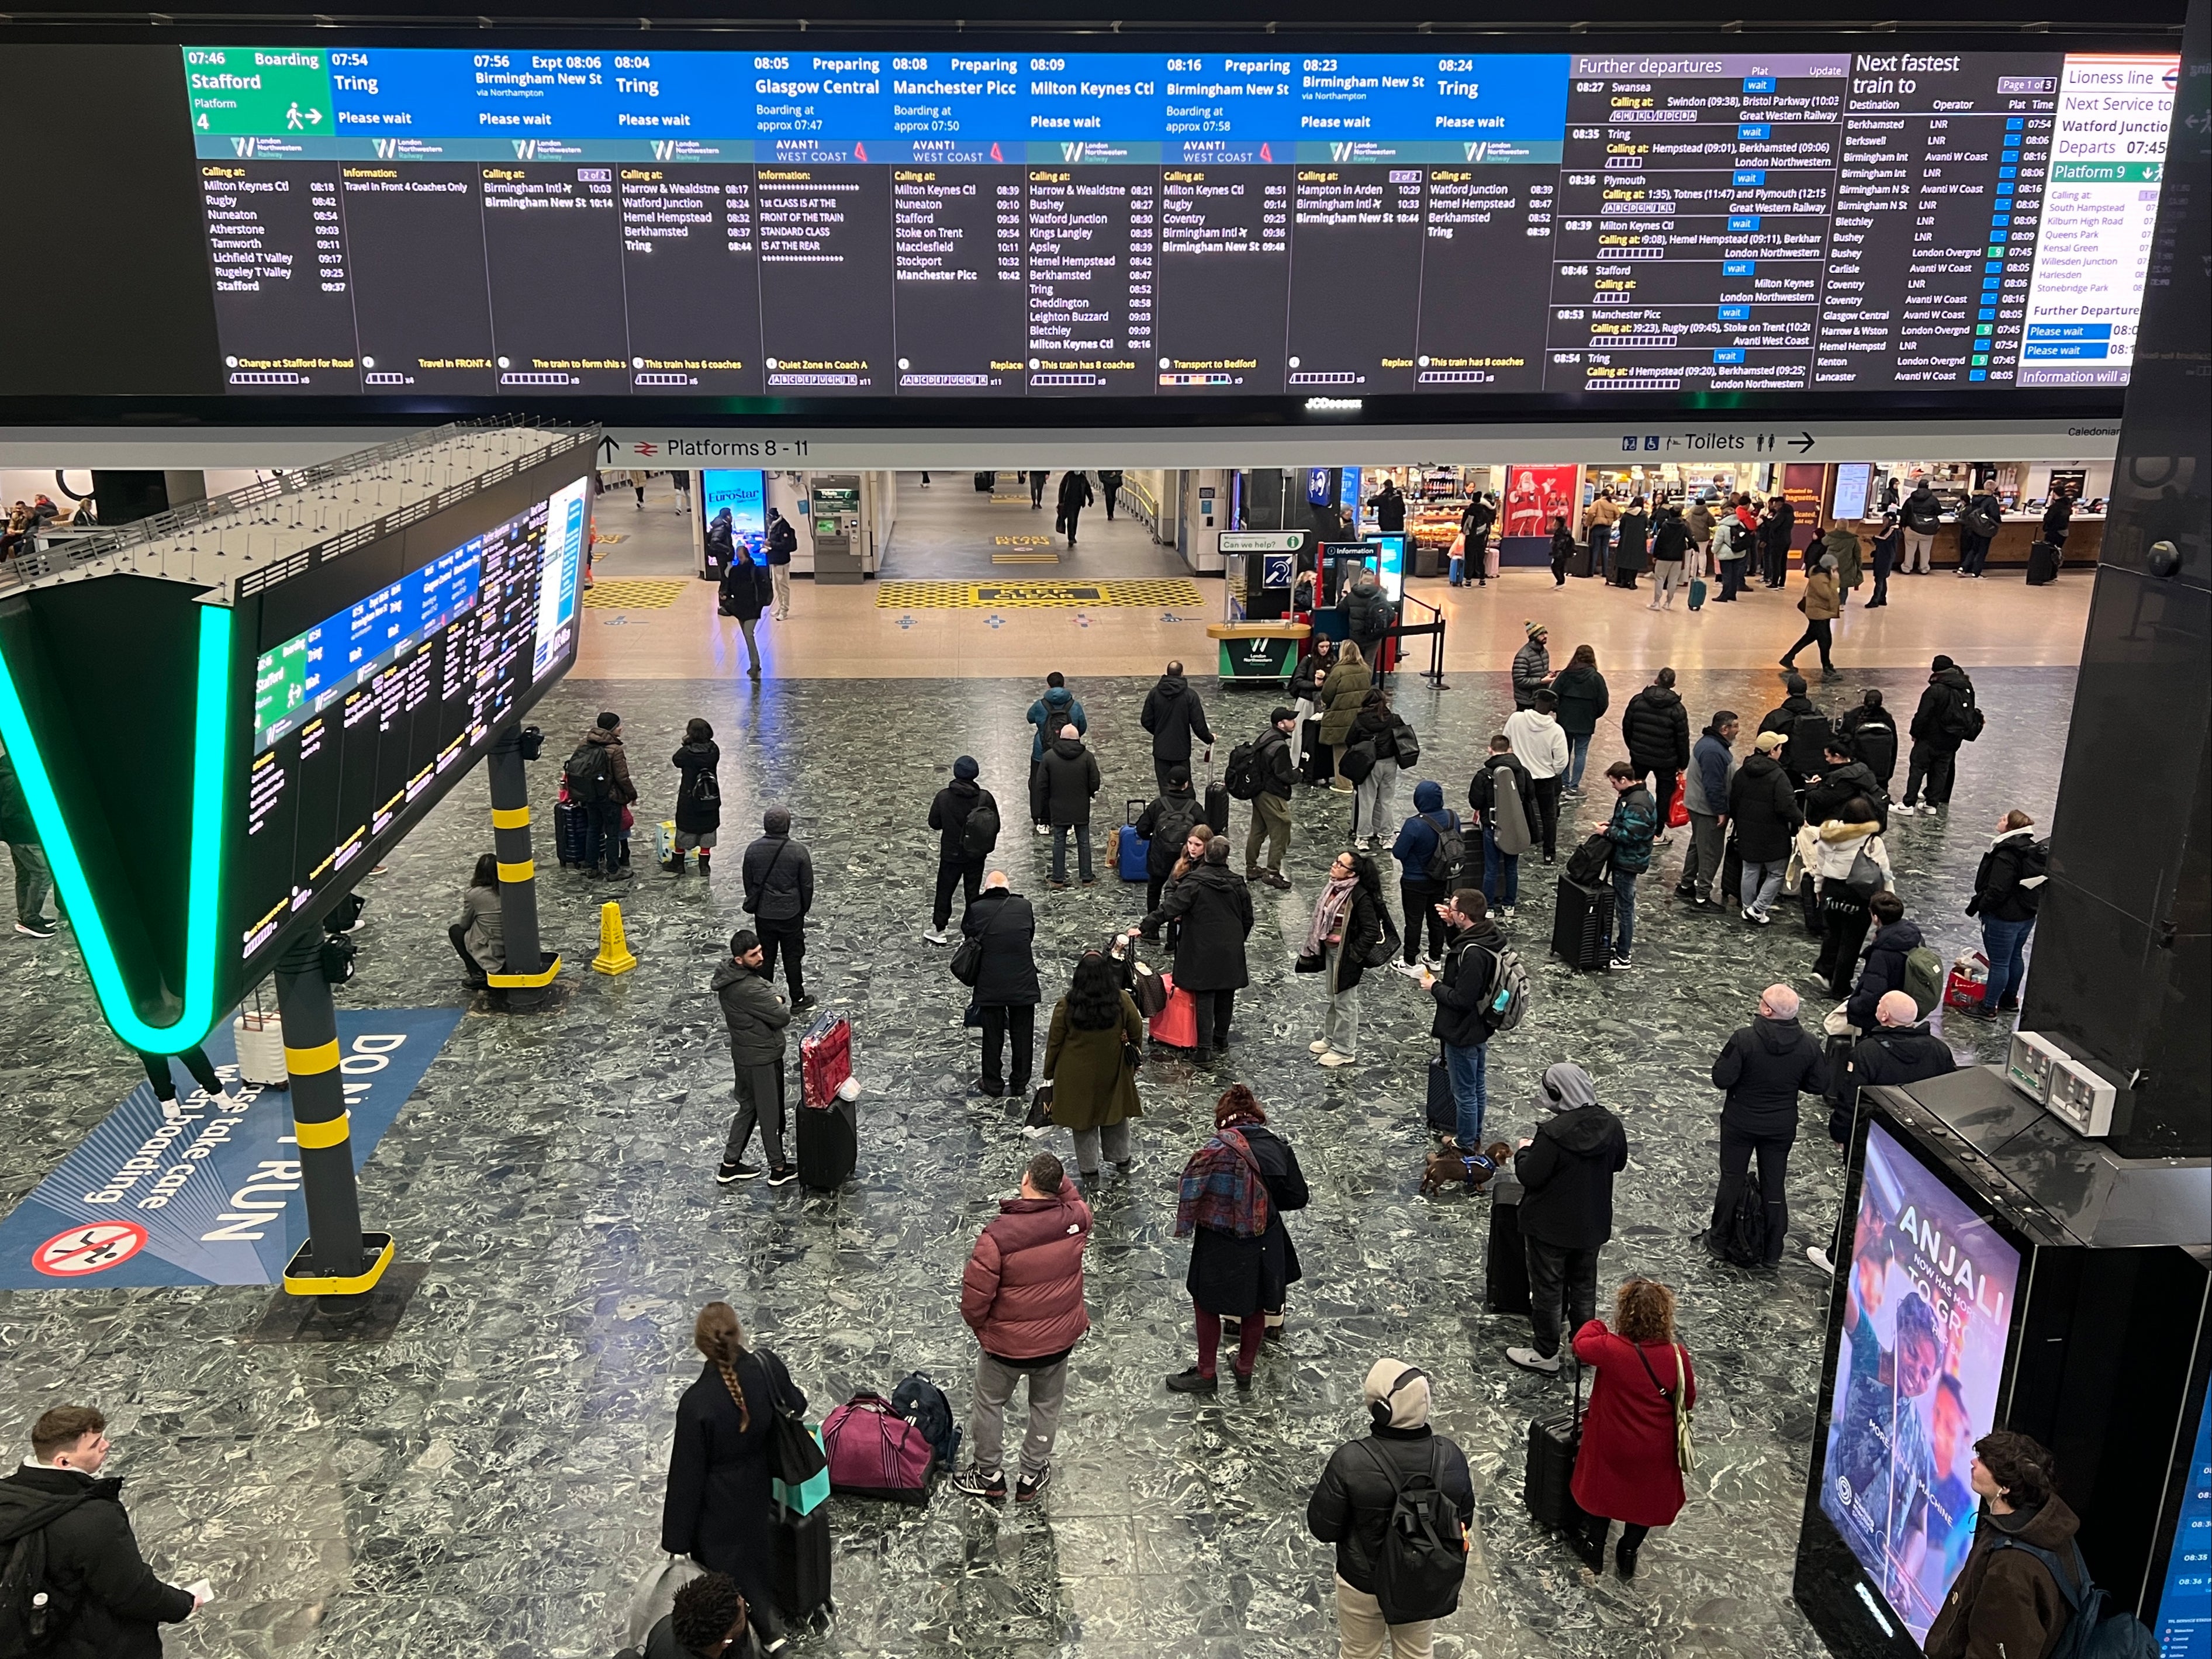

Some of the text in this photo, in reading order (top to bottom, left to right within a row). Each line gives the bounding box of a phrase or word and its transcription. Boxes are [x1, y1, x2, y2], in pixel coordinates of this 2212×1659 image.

[189, 52, 318, 68] 07:46 Boarding
[332, 54, 368, 65] 07:54
[474, 56, 601, 70] 07:56 Expt 08:06
[1031, 59, 1064, 71] 08:09
[1857, 55, 1960, 71] Next fastest
[755, 58, 880, 74] 08:05 Preparing
[893, 58, 1017, 74] 08:08 Preparing
[1167, 60, 1291, 74] 08:16 Preparing
[1579, 59, 1722, 77] Further departures
[1751, 67, 1841, 77] Plat Update
[192, 75, 261, 89] Stafford
[476, 72, 602, 86] Birmingham New St
[2069, 71, 2153, 85] Lioness line
[334, 77, 378, 94] Tring
[755, 80, 879, 96] Glasgow Central
[894, 81, 1016, 95] Manchester Picc
[1031, 82, 1154, 98] Milton Keynes Ctl
[1577, 80, 1767, 92] 08:27 Swansea wait
[1853, 78, 1916, 94] train to
[490, 89, 544, 98] Northampton
[195, 98, 236, 109] Platform
[1850, 99, 2054, 111] Destination Operator Plat Time
[2065, 98, 2172, 112] Next Service to
[756, 104, 814, 117] Boarding at
[198, 113, 209, 129] 4
[338, 112, 412, 124] Please wait
[758, 120, 822, 132] approx 07:47
[1848, 119, 2051, 130] Berkhamsted LNR 07:54
[776, 141, 818, 149] AVANTI
[1846, 136, 2049, 146] Berkswell LNR 08:06
[2059, 141, 2165, 156] Departs 07:45
[777, 152, 846, 162] WEST COAST
[203, 167, 245, 178] Calling at:
[344, 168, 397, 179] Information:
[2055, 165, 2125, 178] Platform 9
[205, 181, 334, 193] Milton Keynes Ctl 08:18
[1569, 175, 1646, 187] 08:36 Plymouth
[622, 183, 748, 195] Harrow & Wealdstne 08:17
[207, 195, 336, 208] Rugby 08:42
[2050, 203, 2124, 213] South Hampstead
[208, 210, 337, 221] Nuneaton 08:54
[1163, 213, 1285, 225] Coventry 09:25
[2047, 217, 2123, 226] Kilburn High Road
[210, 224, 339, 235] Atherstone 09:03
[896, 227, 1019, 239] Stoke on Trent 09:54
[2046, 230, 2099, 240] Queens Park
[897, 241, 1018, 252] Macclesfield 10:11
[1030, 241, 1152, 253] Apsley 08:39
[897, 255, 1019, 267] Stockport 10:32
[217, 281, 345, 292] Stafford 09:37
[1030, 298, 1151, 309] Cheddington 08:58
[1030, 311, 1150, 323] Leighton Buzzard 09:03
[1174, 358, 1256, 370] Transport to Bedford
[668, 440, 759, 457] Platforms
[765, 441, 776, 455] 8
[794, 441, 808, 455] 11
[1685, 434, 1744, 451] Toilets
[709, 489, 759, 503] Eurostar
[1255, 541, 1276, 549] help?
[340, 1035, 406, 1074] DO
[84, 1115, 205, 1203] boarding
[138, 1117, 243, 1209] take care
[201, 1160, 302, 1240] RUN
[1900, 1205, 2003, 1326] ANJALI
[1914, 1253, 1934, 1278] NOW
[1935, 1274, 1952, 1297] HAS
[1908, 1266, 1931, 1304] TO
[1869, 1419, 1890, 1449] MORE
[1918, 1479, 1954, 1529] MACHINE
[2184, 1554, 2208, 1562] 08:35
[2179, 1578, 2203, 1587] 08:36
